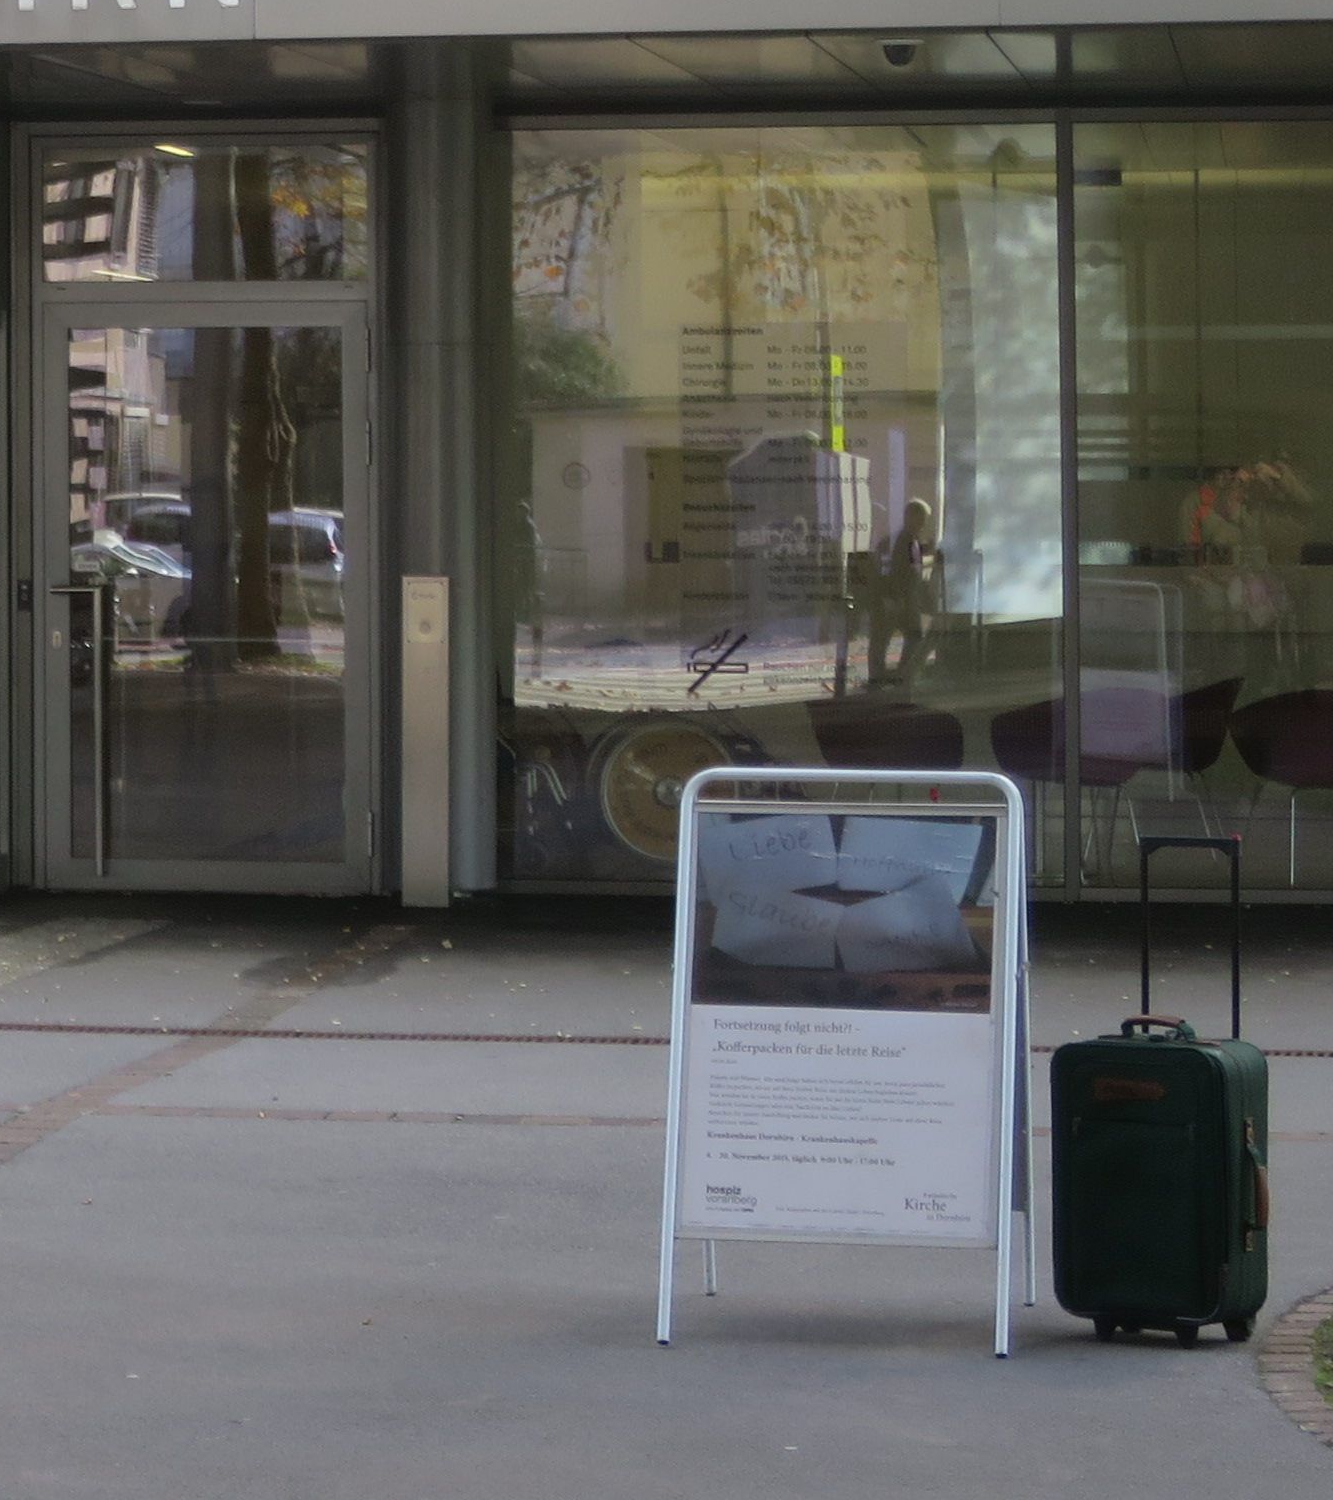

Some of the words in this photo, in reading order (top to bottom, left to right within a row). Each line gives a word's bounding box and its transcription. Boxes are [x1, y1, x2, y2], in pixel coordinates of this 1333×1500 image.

[729, 827, 812, 861] Liebe
[714, 1018, 783, 1035] Fortsetzung
[784, 1020, 811, 1035] folgt
[795, 1042, 814, 1055] für
[815, 1043, 833, 1056] die
[836, 1043, 869, 1057] letzte
[706, 1184, 742, 1196] hospiz
[904, 1197, 947, 1212] Kirche
